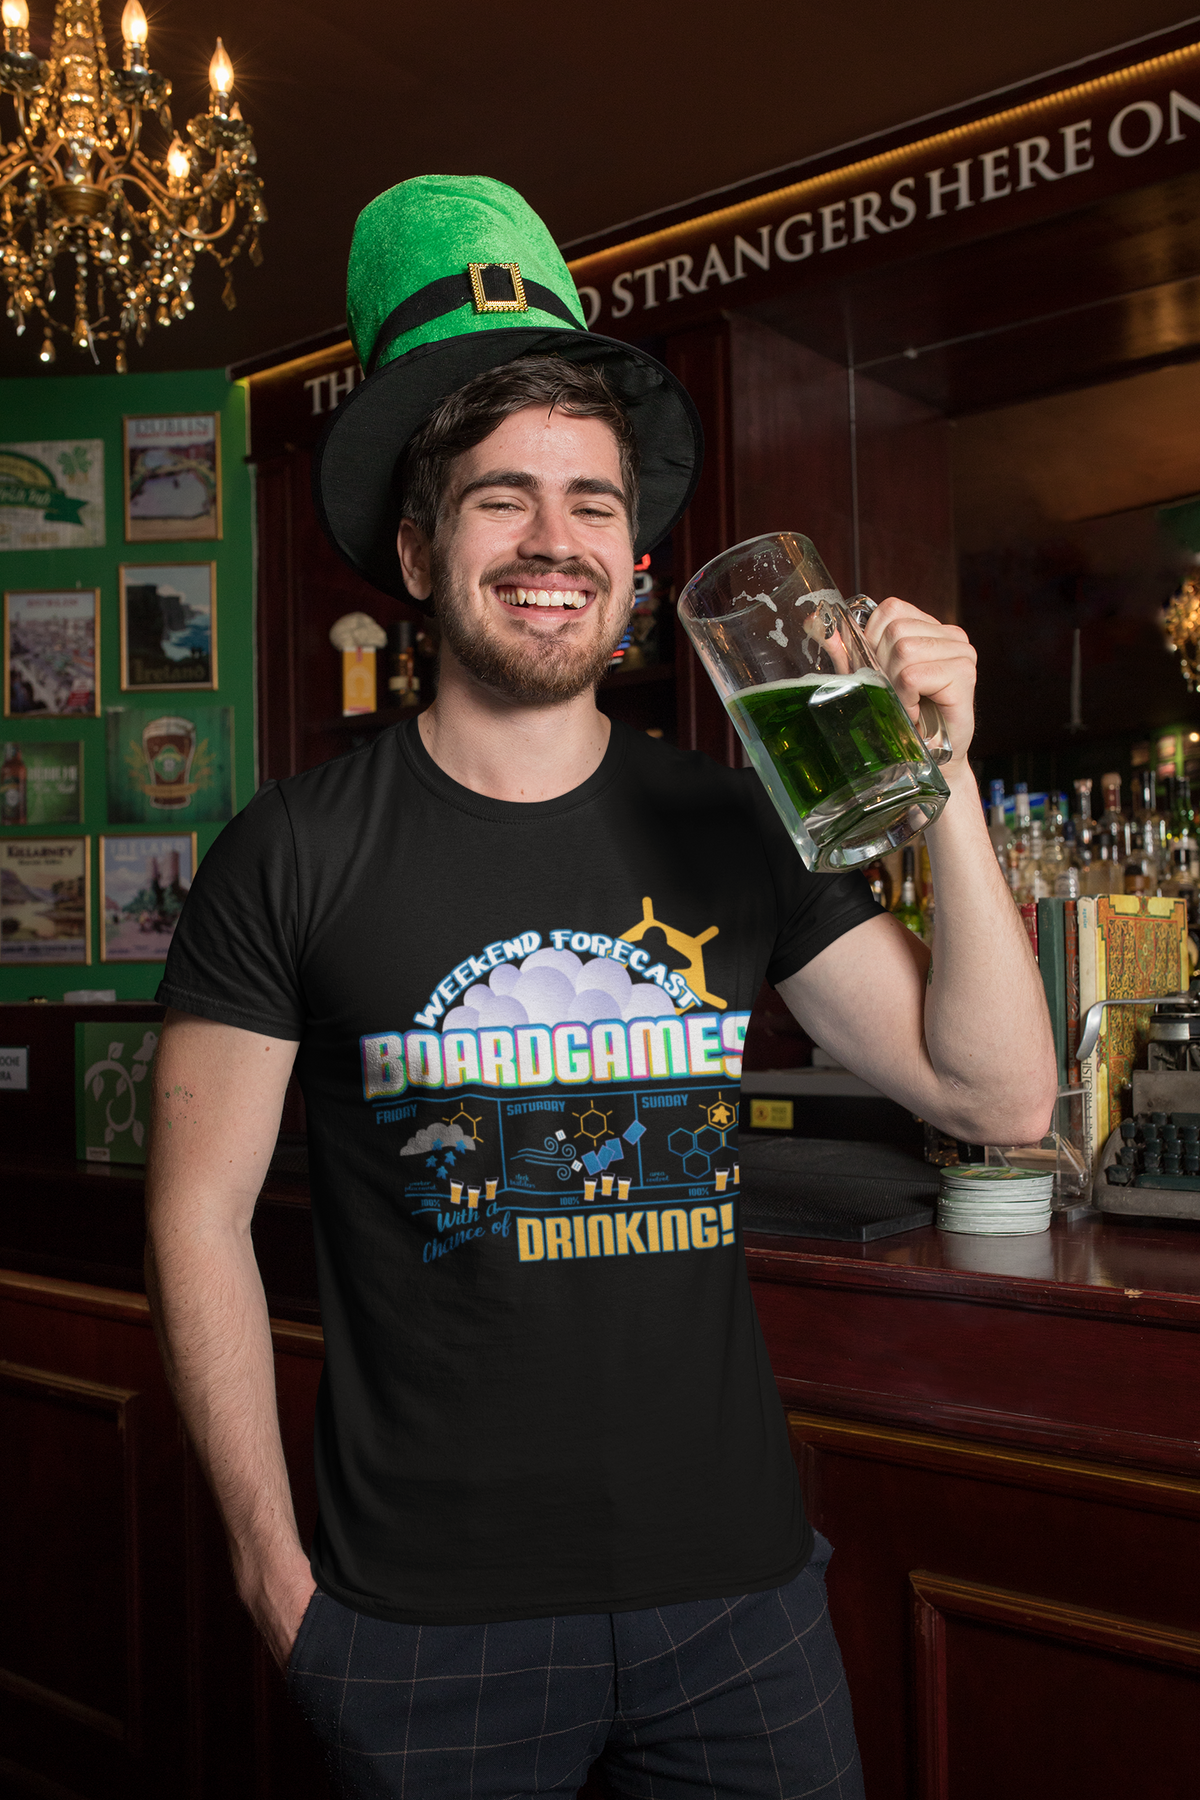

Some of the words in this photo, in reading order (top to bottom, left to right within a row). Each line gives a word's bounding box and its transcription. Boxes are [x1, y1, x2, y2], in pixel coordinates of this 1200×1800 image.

[303, 363, 366, 416] TH
[577, 285, 601, 328] O
[611, 176, 918, 319] STRANGERS
[925, 119, 1095, 219] HERE
[8, 845, 77, 858] KILLARNEY
[413, 930, 542, 1028] WEEKEND
[550, 929, 703, 1009] FORECAST
[359, 1010, 751, 1101] BOARDGAMES
[506, 1100, 566, 1116] SATURDAY
[641, 1094, 689, 1109] SUNDAY
[376, 1103, 418, 1125] FRIDAY
[420, 1198, 441, 1208] 100%
[559, 1196, 580, 1206] 100%
[688, 1186, 710, 1198] 100%
[437, 1207, 480, 1233] With
[486, 1201, 501, 1217] a
[422, 1225, 486, 1264] Chance
[491, 1210, 511, 1238] of
[516, 1201, 735, 1263] DRINKING!
